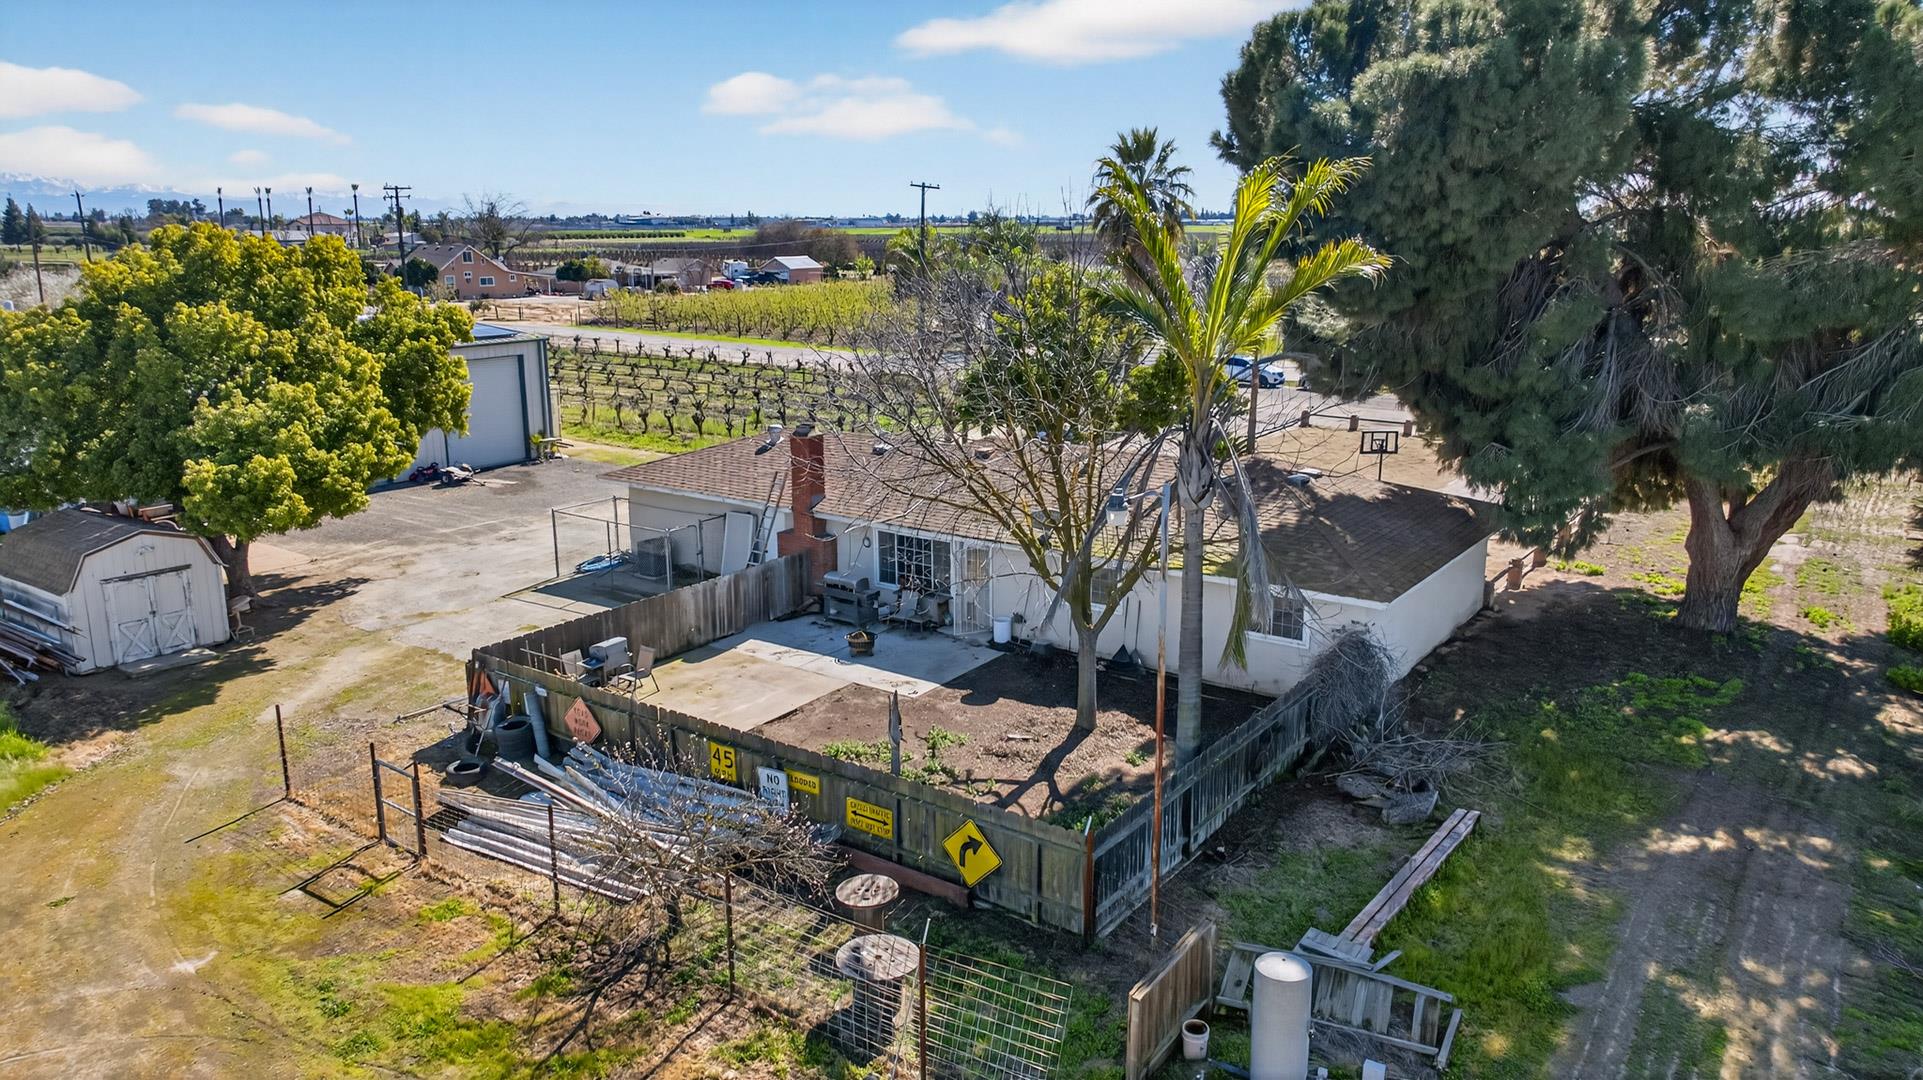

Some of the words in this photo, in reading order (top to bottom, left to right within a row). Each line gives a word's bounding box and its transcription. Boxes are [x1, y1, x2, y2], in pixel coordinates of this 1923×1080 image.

[712, 747, 733, 769] 45
[766, 773, 780, 786] NO
[789, 774, 817, 789] LOODED
